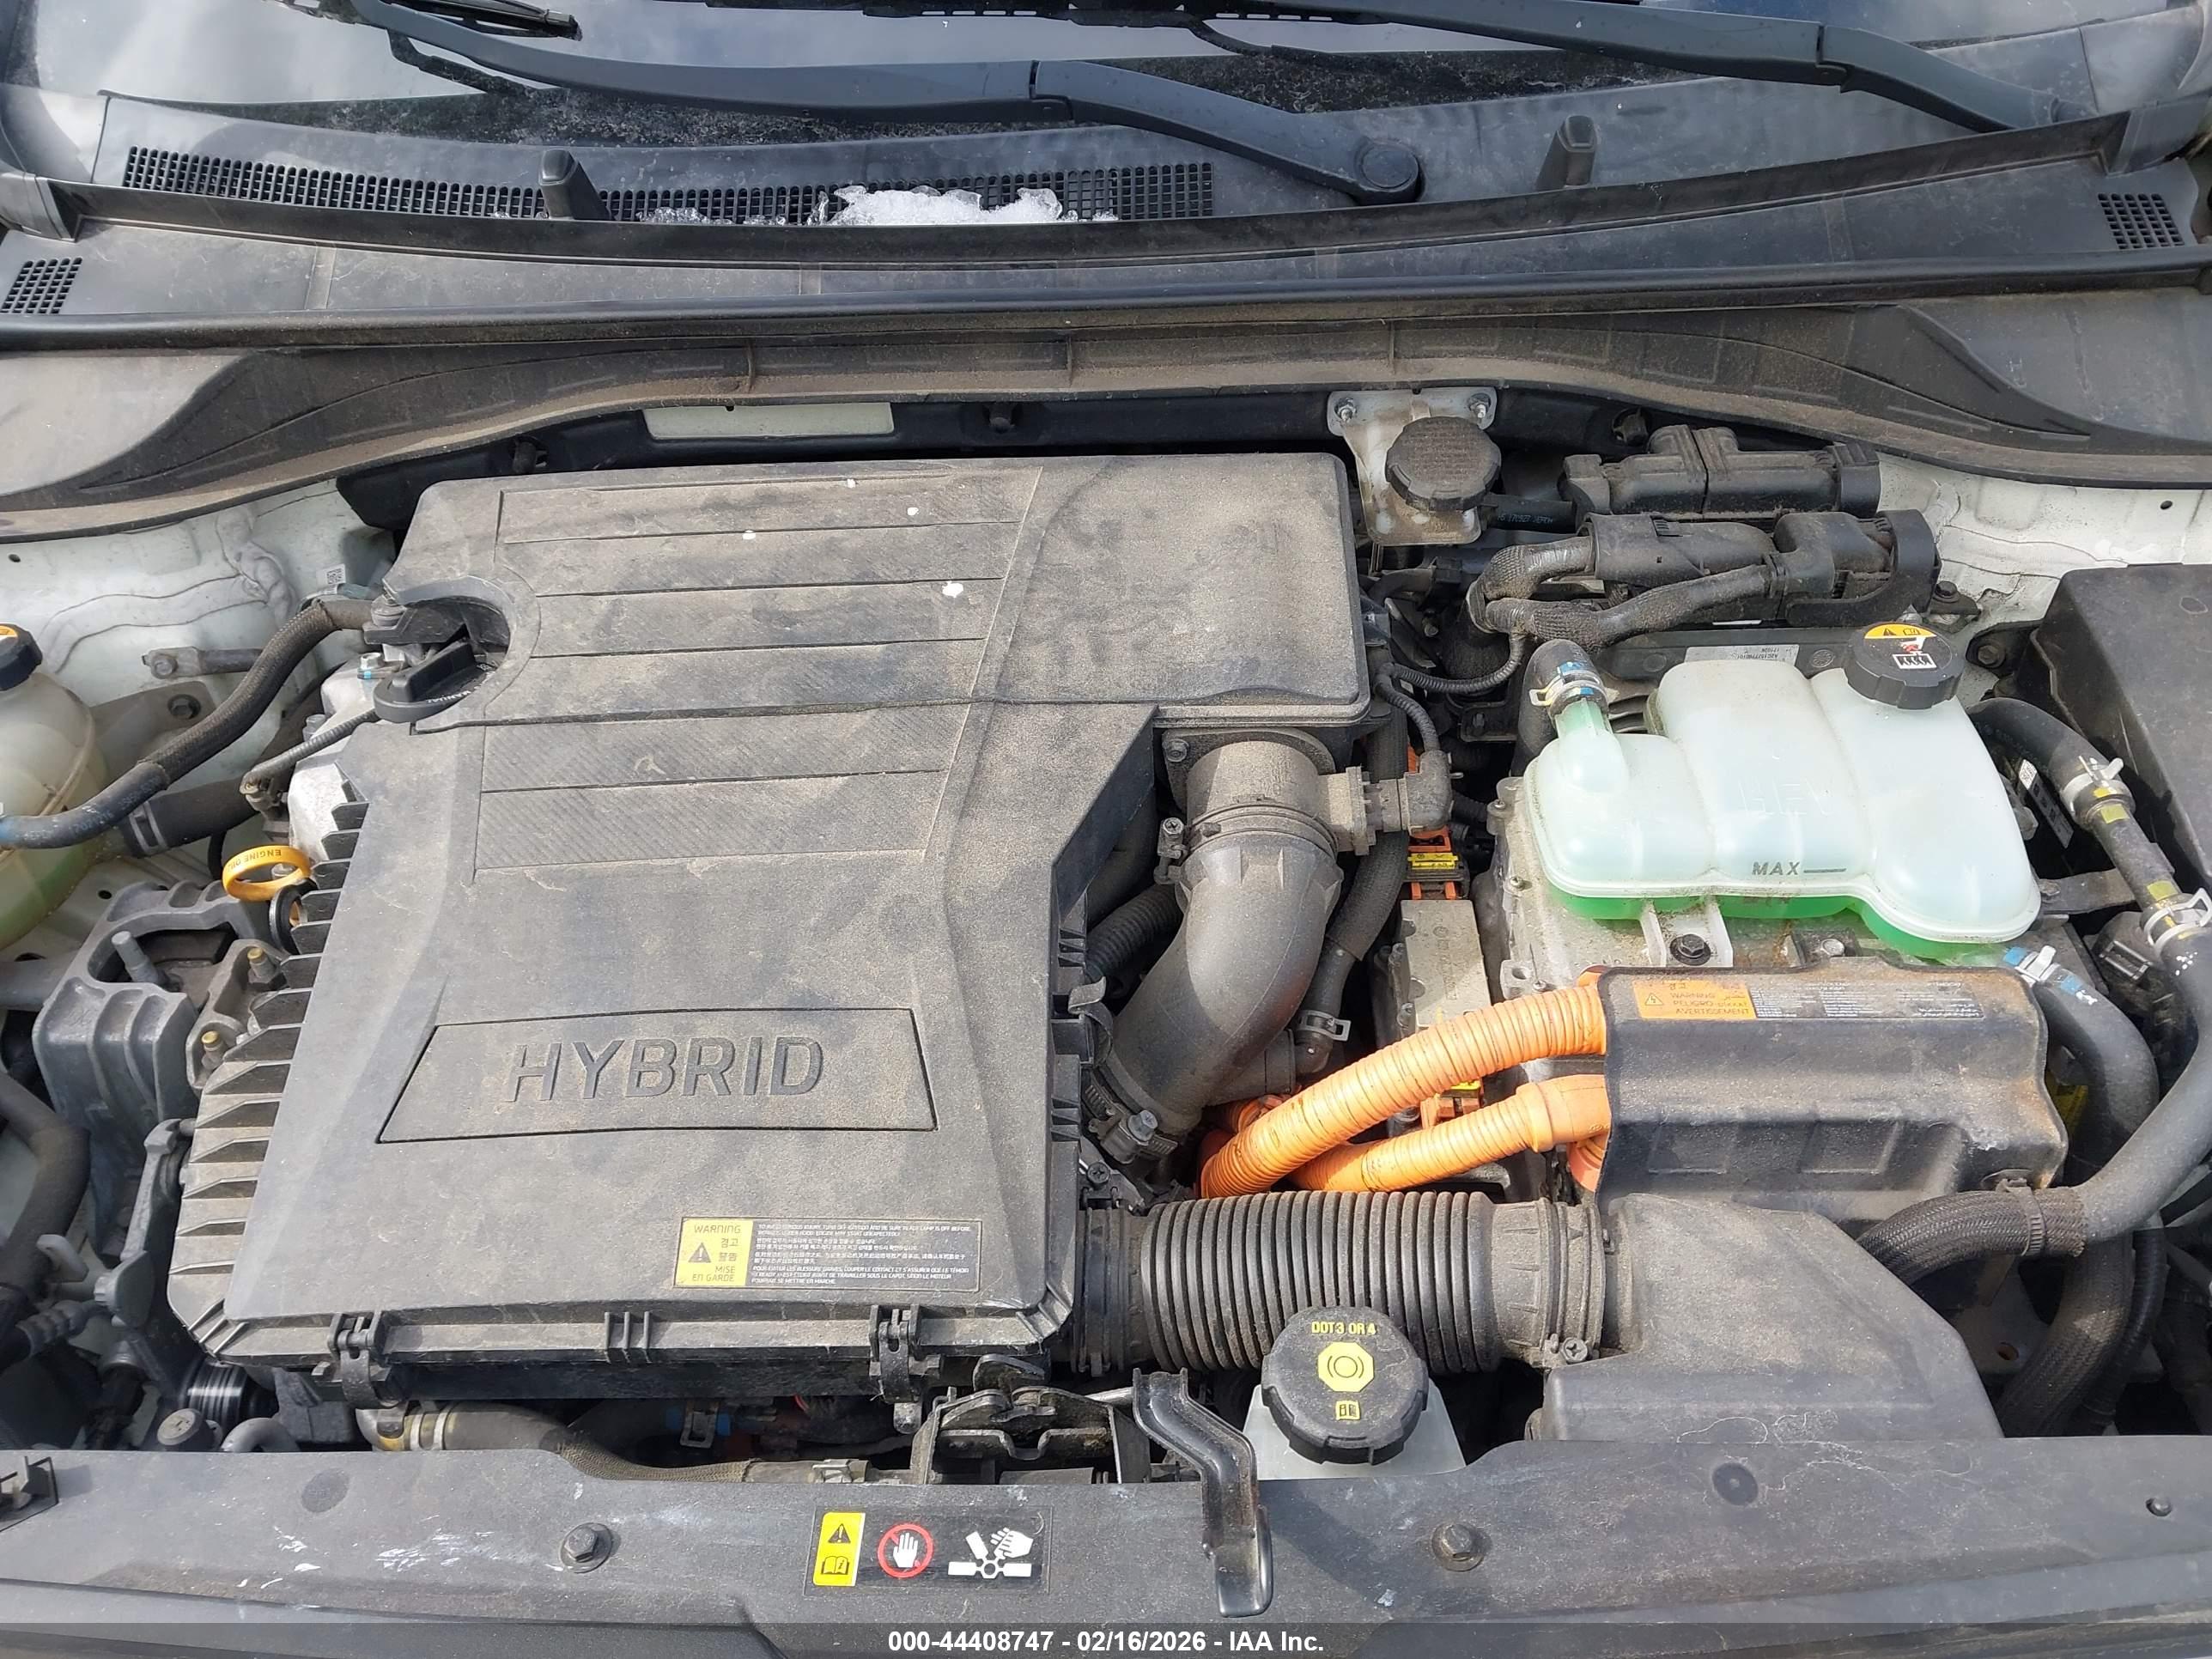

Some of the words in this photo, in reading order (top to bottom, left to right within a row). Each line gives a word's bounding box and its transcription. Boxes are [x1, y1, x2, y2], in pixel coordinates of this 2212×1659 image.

[426, 690, 471, 703] MANUAL
[244, 849, 282, 863] ENGINE
[1752, 861, 1799, 875] MAX
[505, 1036, 824, 1103] HYBRID
[694, 1224, 742, 1234] WARNING
[692, 1273, 703, 1282] EN
[706, 1273, 735, 1282] GARDE
[1348, 1322, 1365, 1334] OR
